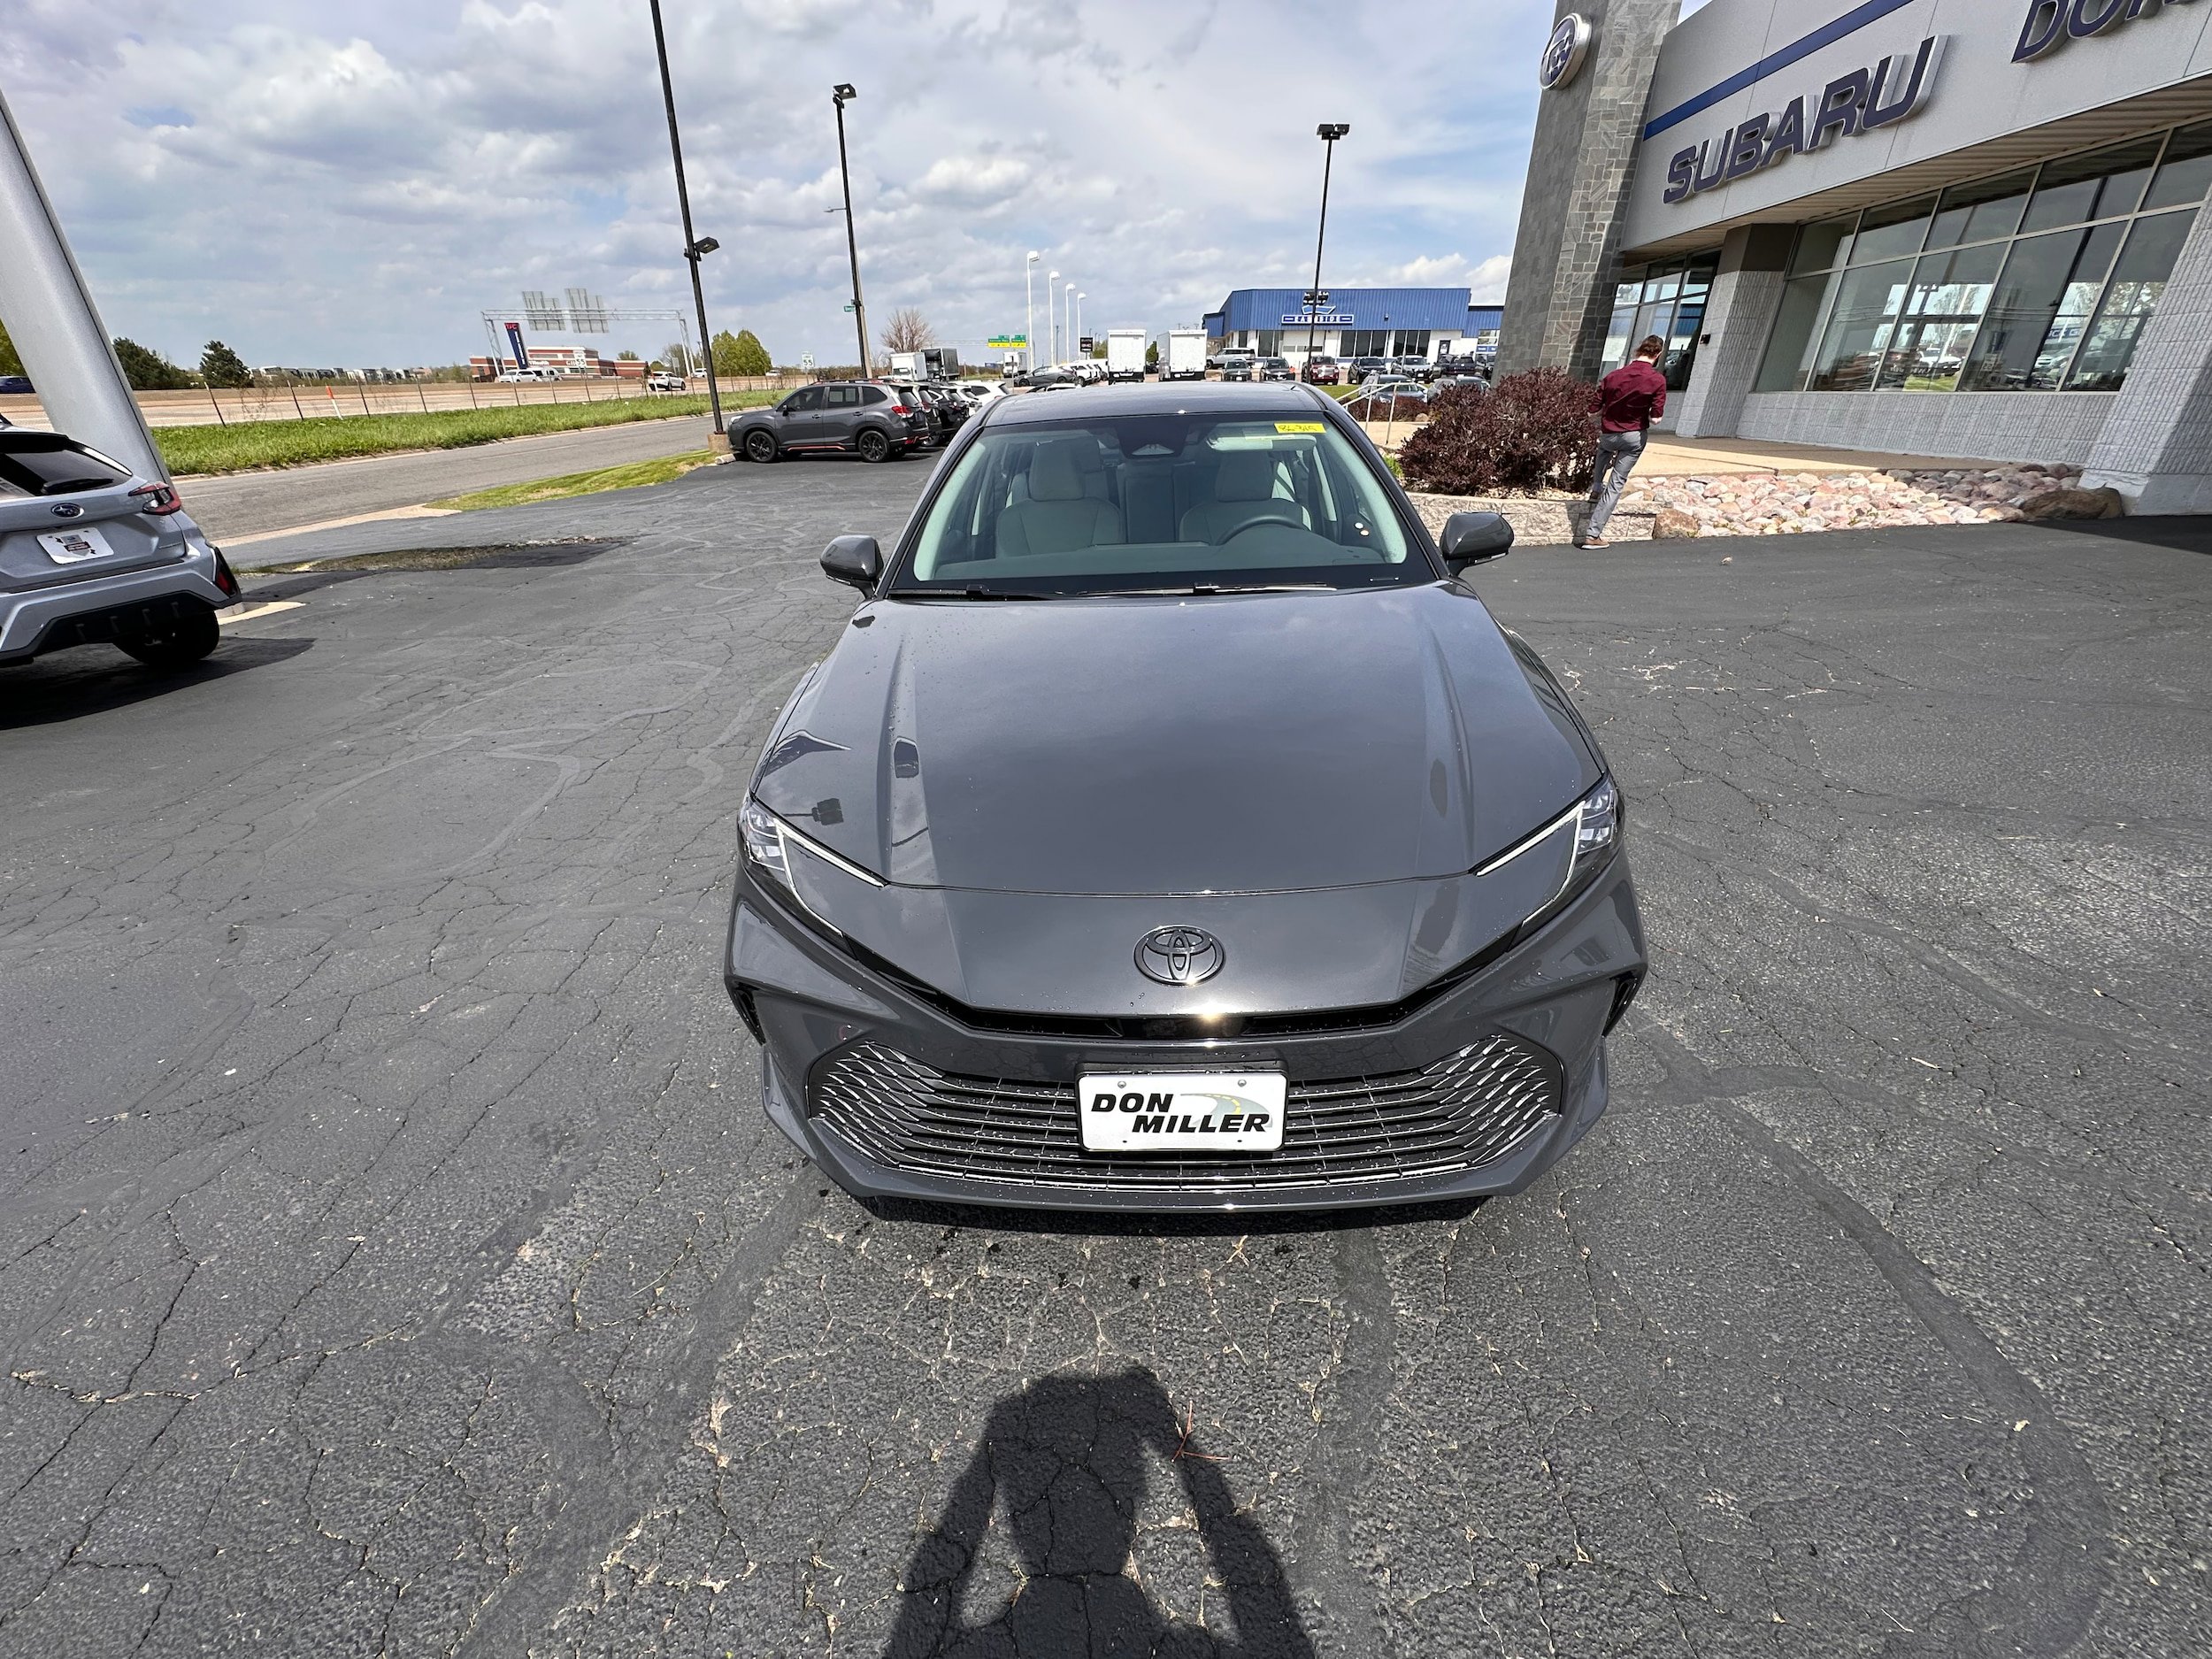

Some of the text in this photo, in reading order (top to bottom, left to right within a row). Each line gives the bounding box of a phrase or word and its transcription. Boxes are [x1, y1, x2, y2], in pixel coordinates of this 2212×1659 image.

[1663, 35, 1943, 204] SUBARU
[1090, 1093, 1174, 1113] DON
[1132, 1113, 1271, 1133] MILLER
